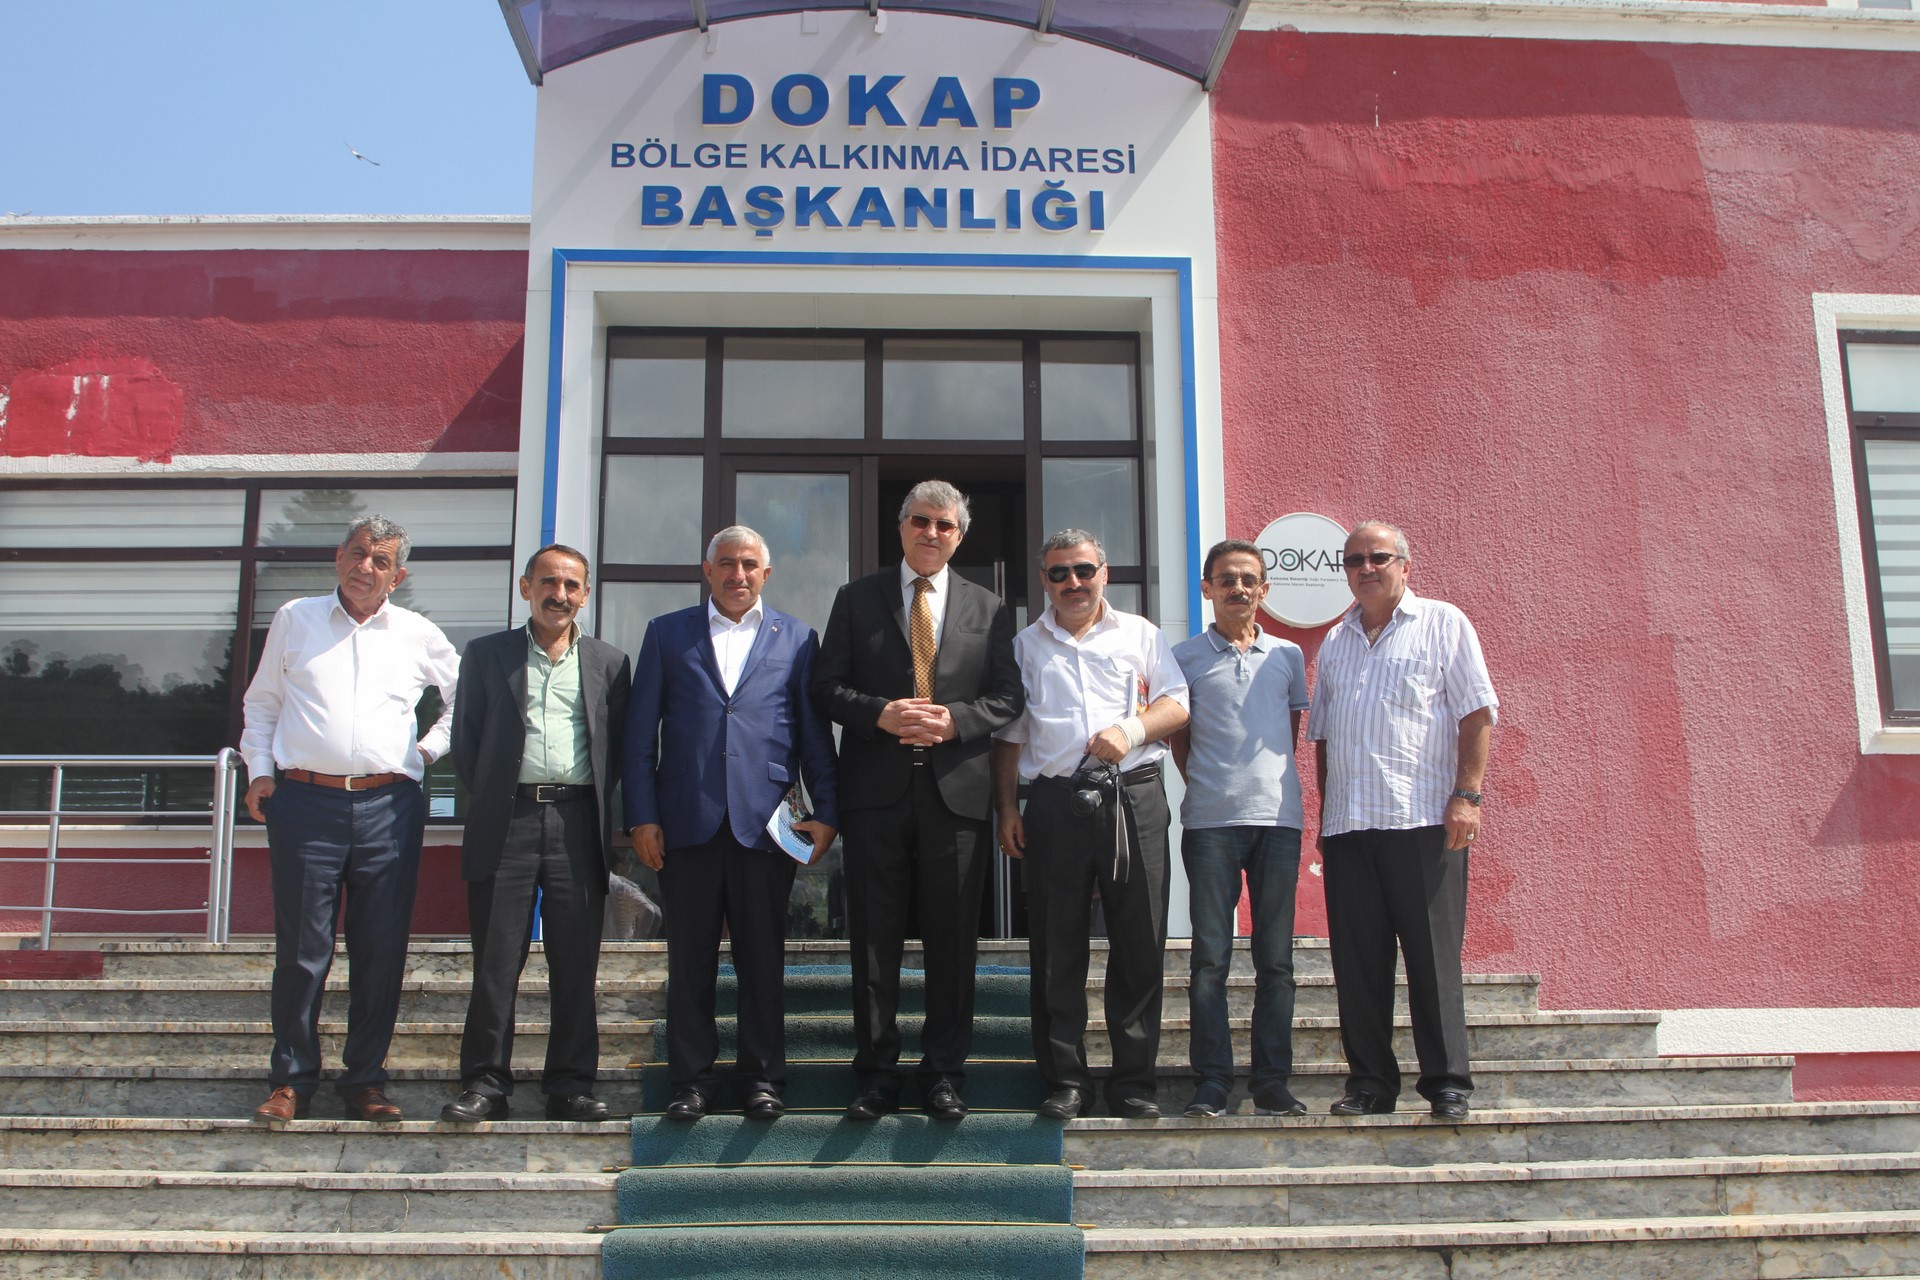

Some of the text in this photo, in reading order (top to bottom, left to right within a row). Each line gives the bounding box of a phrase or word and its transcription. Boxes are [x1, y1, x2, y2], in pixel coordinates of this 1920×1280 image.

[702, 73, 1041, 130] DOKAP
[611, 138, 1136, 175] BÖLGE KALKINMA İDARESİ
[641, 180, 1105, 239] BAŞKANLIĞI
